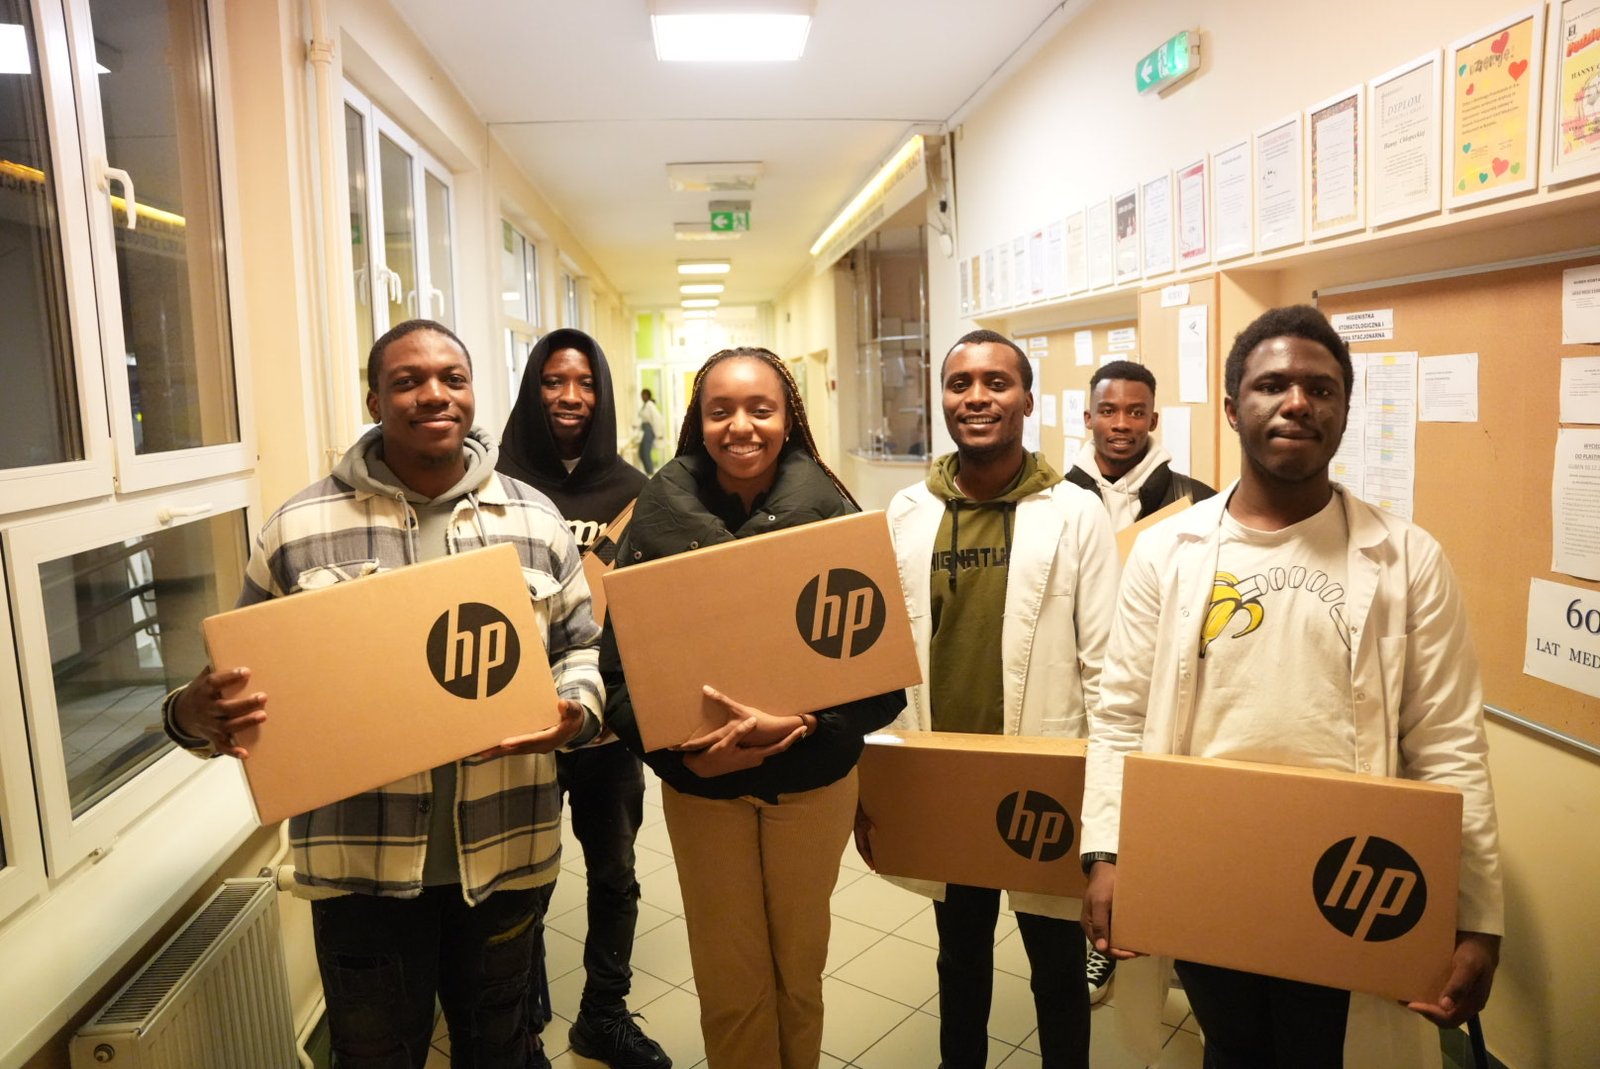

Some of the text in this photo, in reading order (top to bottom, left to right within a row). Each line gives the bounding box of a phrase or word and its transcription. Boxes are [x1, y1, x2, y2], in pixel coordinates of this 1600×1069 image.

[443, 603, 508, 699] hp
[811, 569, 875, 659] hp
[1537, 638, 1560, 656] LAT
[1006, 791, 1066, 861] hp
[1324, 836, 1417, 941] hp
